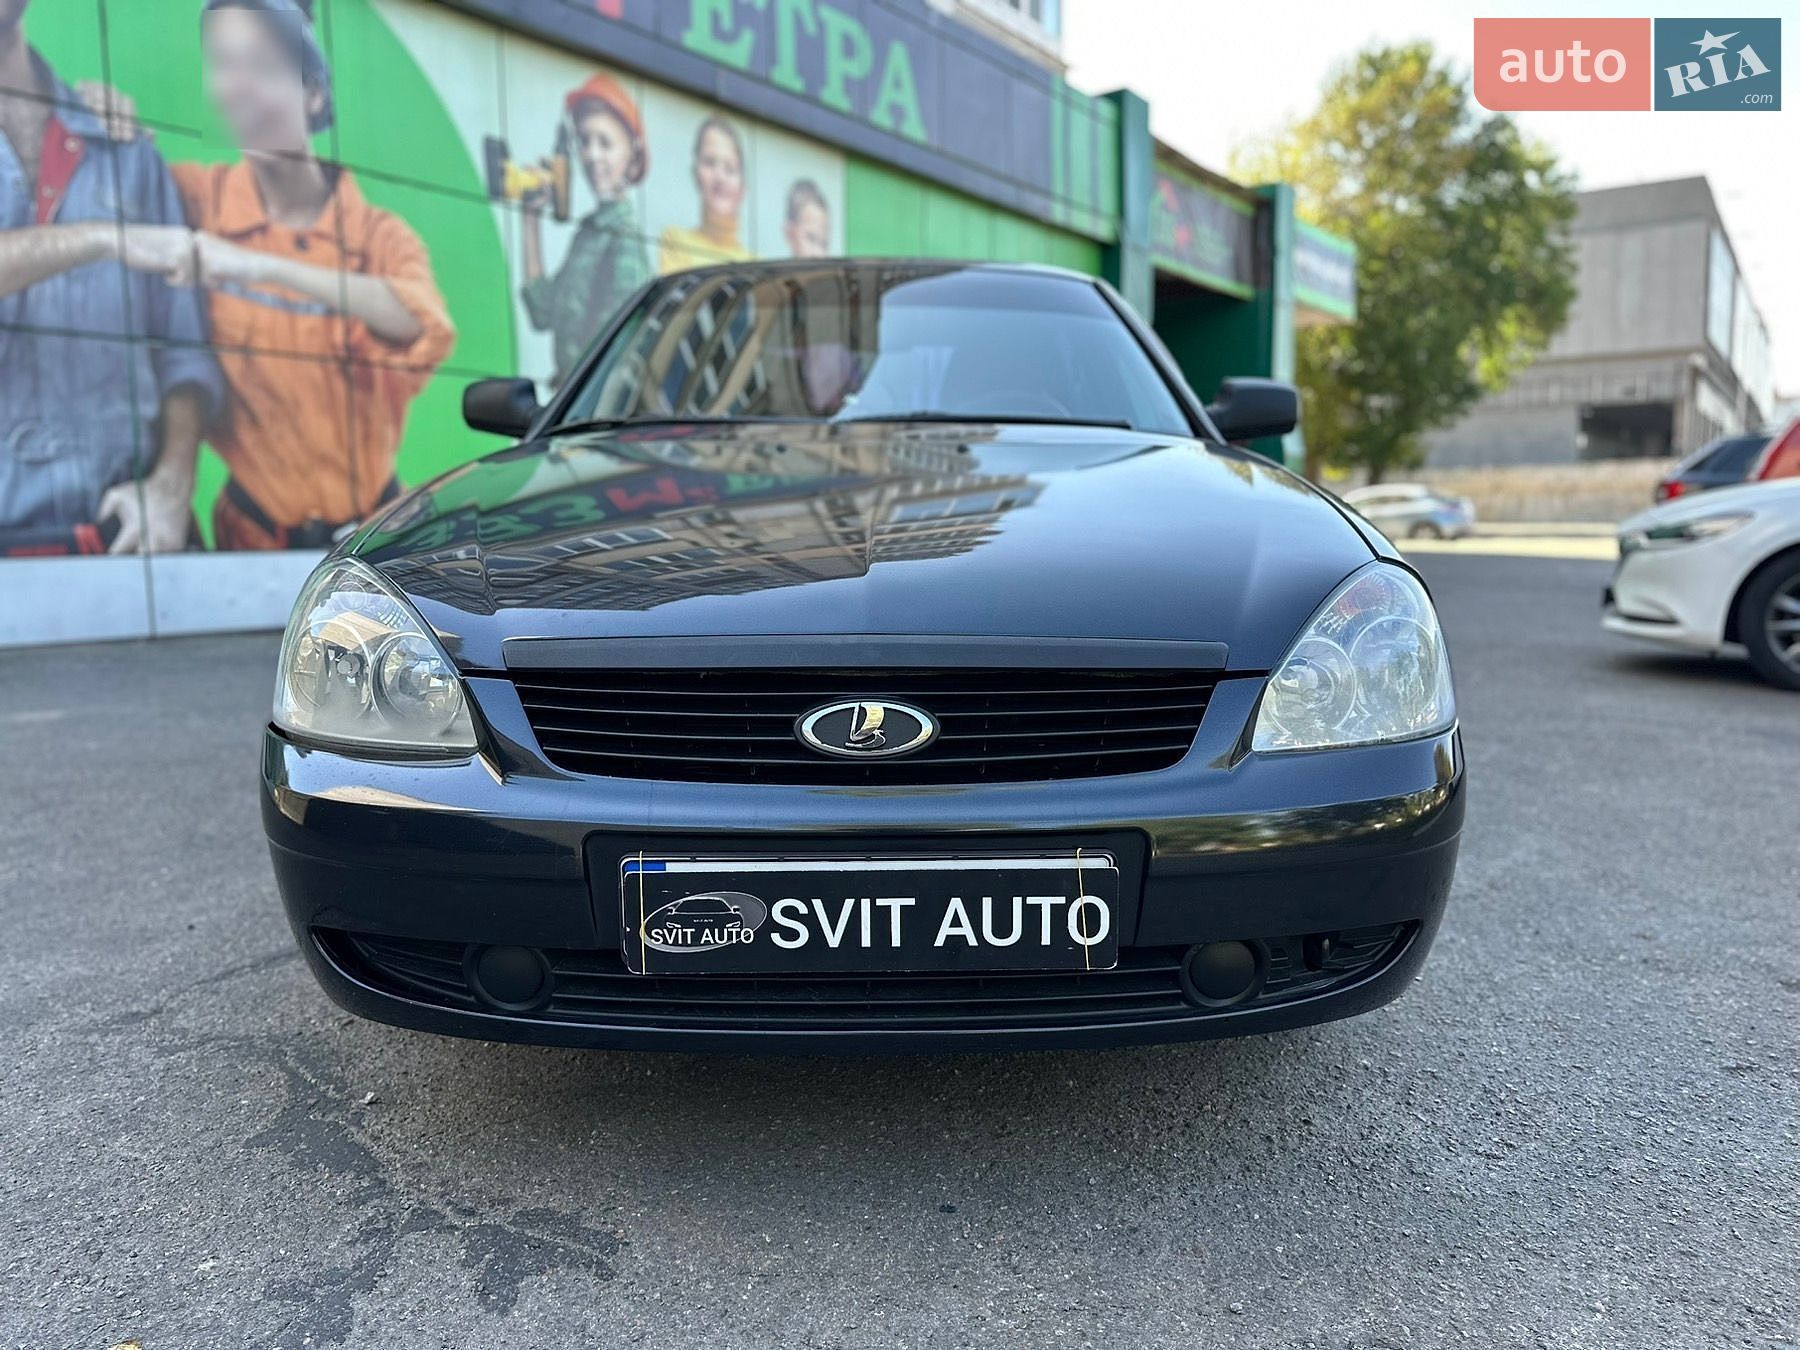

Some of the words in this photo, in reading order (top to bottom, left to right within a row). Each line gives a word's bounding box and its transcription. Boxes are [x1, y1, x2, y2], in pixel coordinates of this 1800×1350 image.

[650, 927, 696, 945] SVIT
[700, 927, 754, 944] AUTO
[770, 897, 916, 949] SVIT
[933, 895, 1111, 947] AUTO
